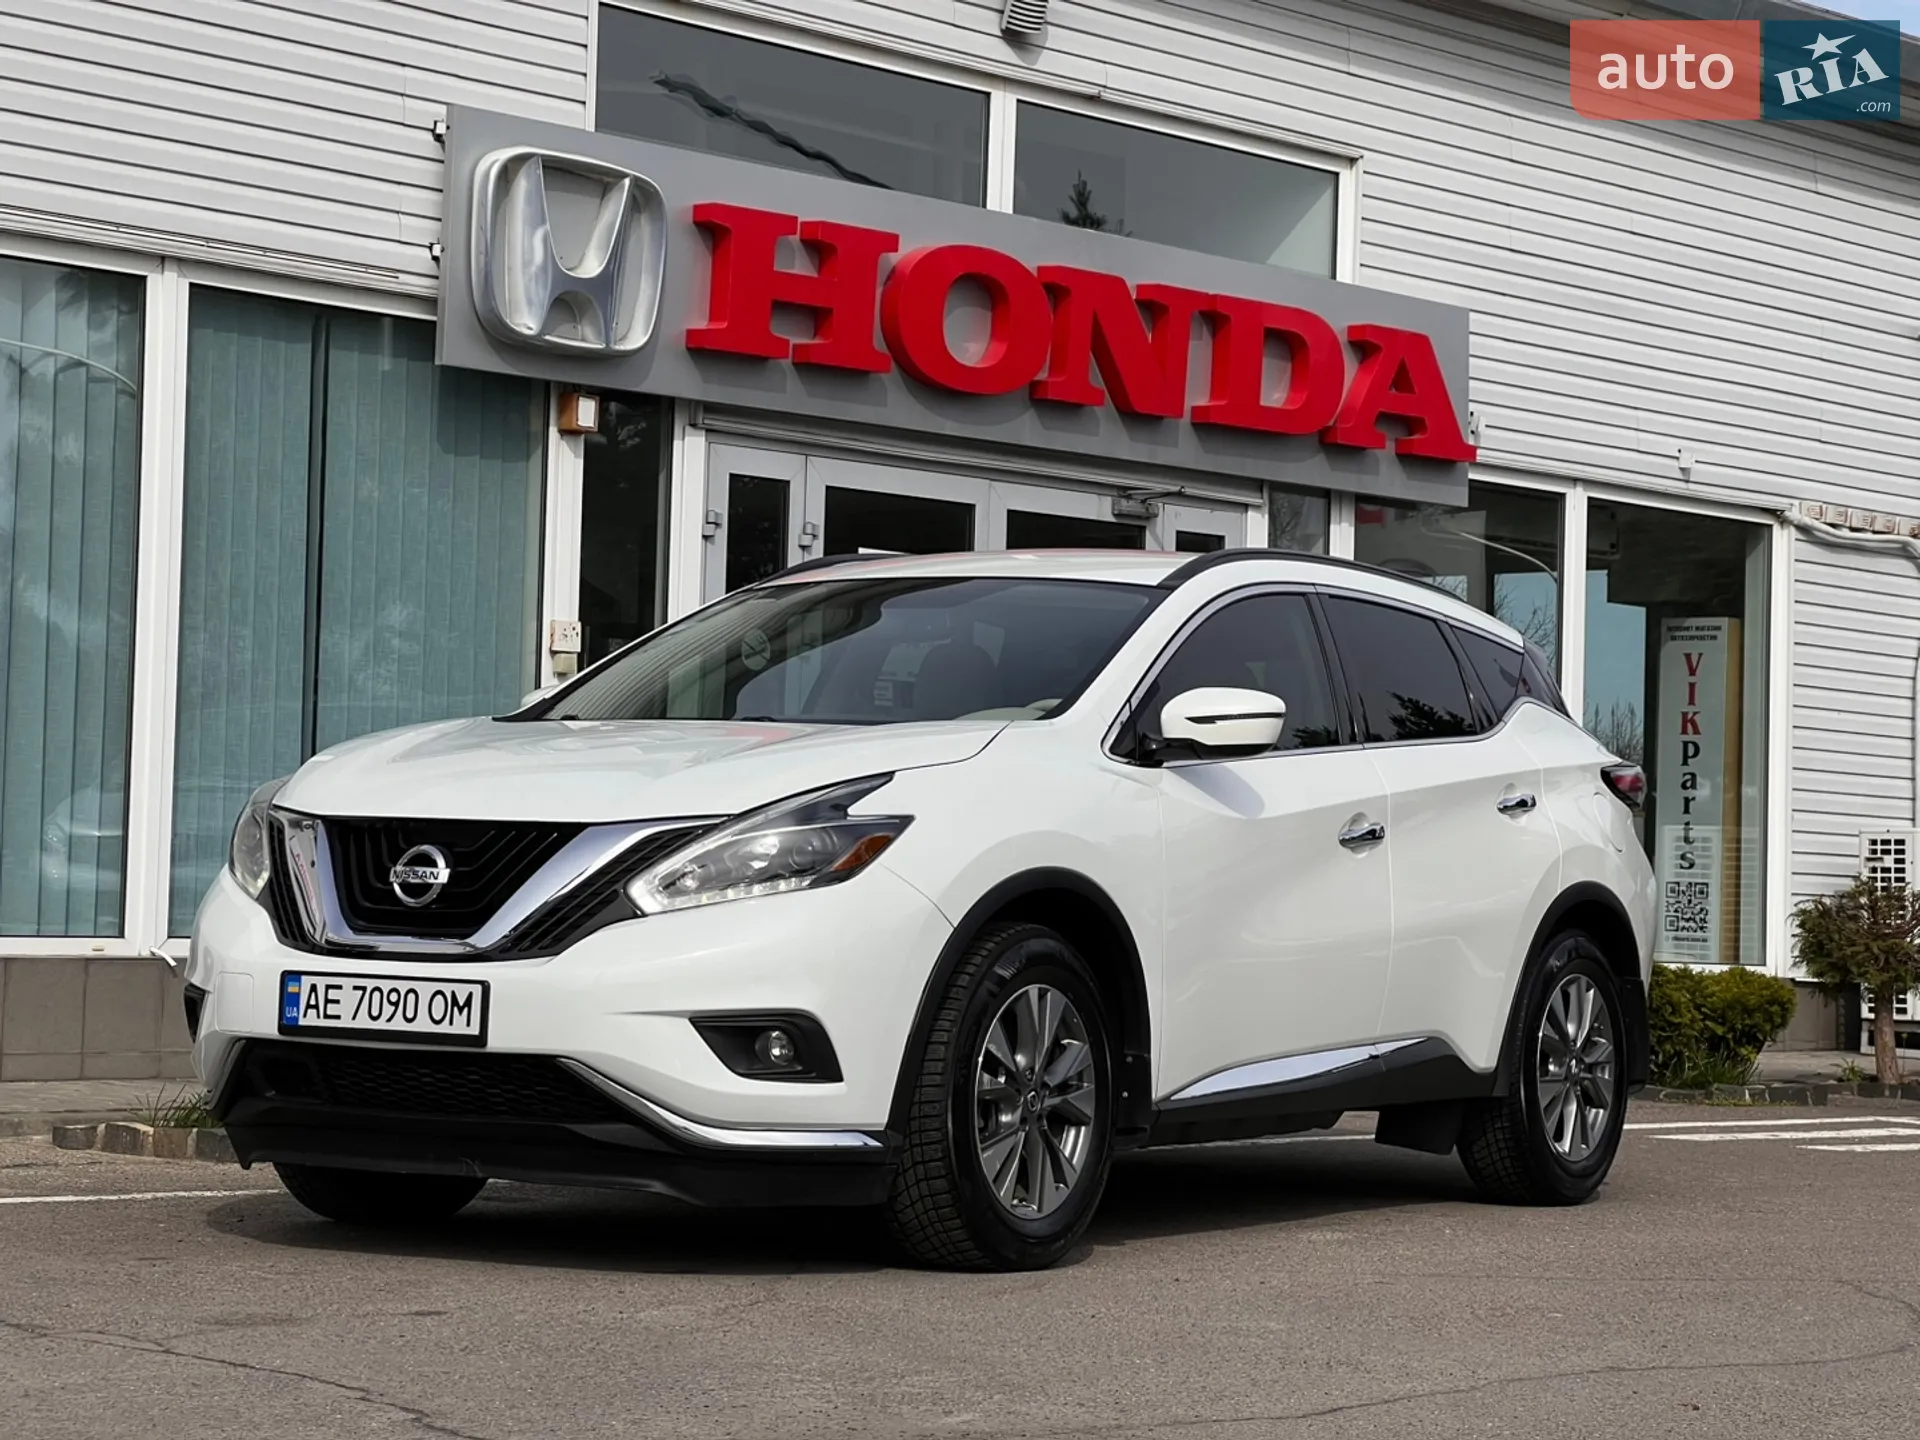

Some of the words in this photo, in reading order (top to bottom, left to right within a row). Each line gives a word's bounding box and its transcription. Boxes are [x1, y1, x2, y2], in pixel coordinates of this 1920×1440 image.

[685, 202, 1478, 463] HONDA
[391, 869, 440, 882] NISSAN
[285, 1006, 299, 1018] UA
[303, 983, 343, 1020] AE
[351, 985, 420, 1024] 7090
[428, 989, 474, 1027] OM
